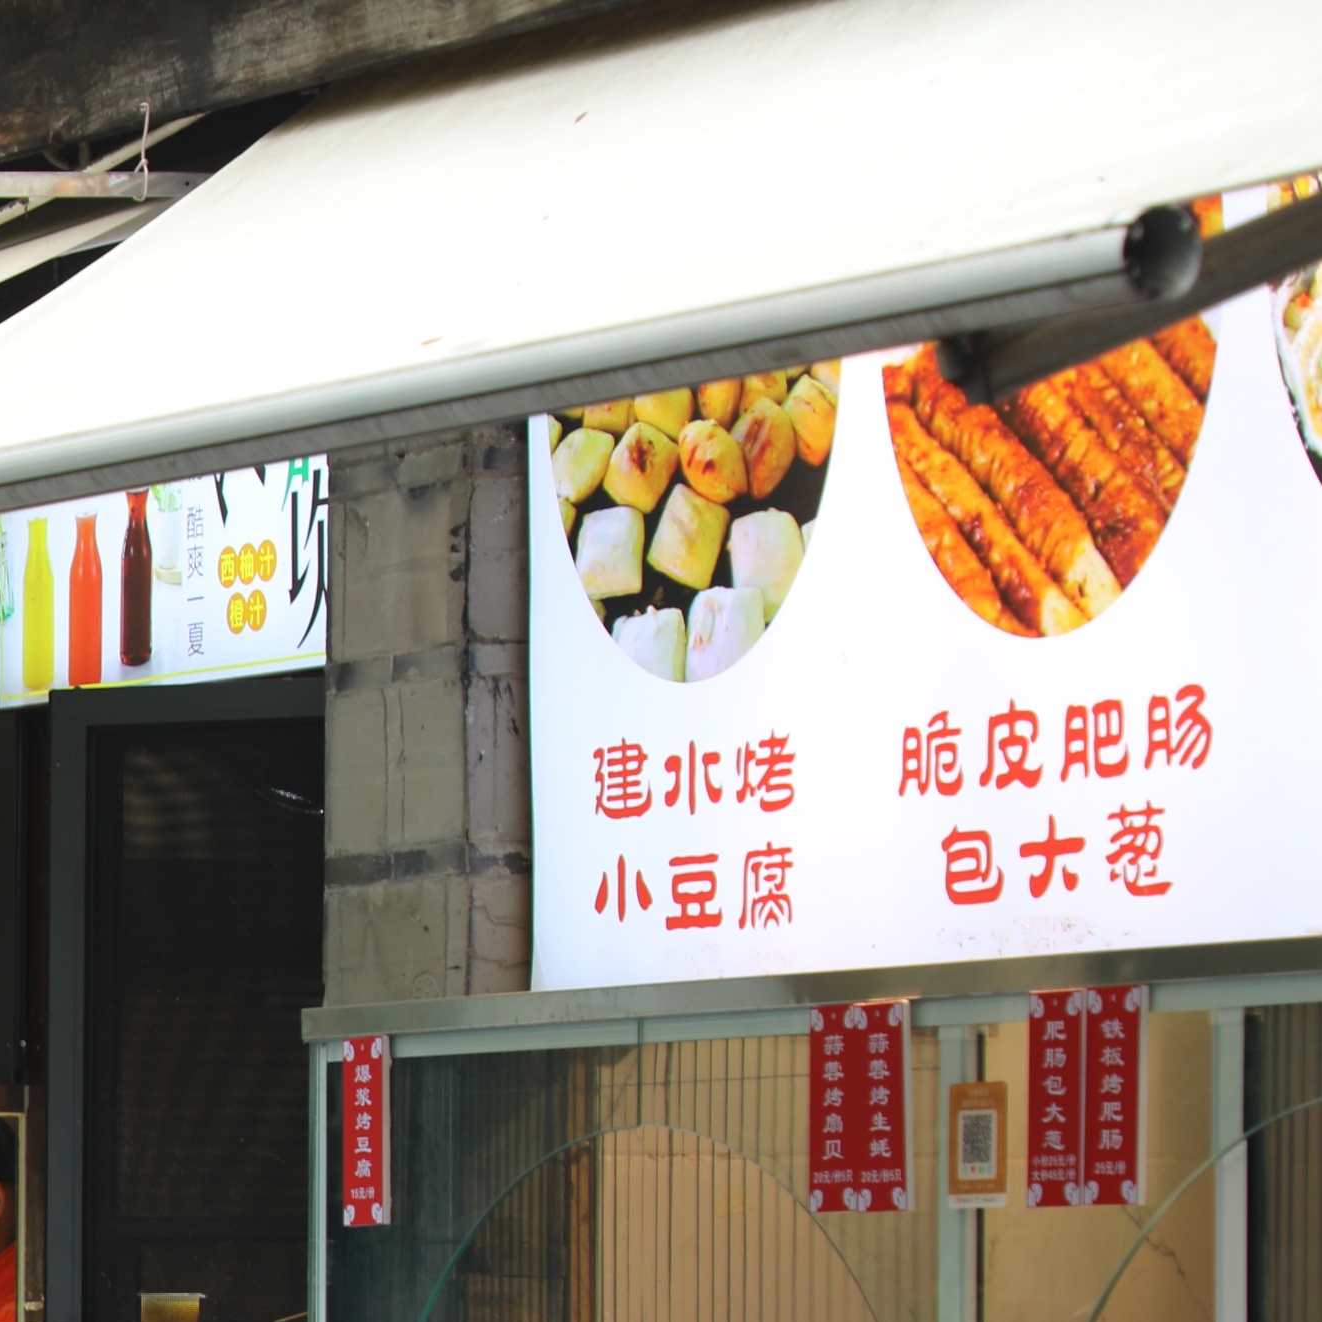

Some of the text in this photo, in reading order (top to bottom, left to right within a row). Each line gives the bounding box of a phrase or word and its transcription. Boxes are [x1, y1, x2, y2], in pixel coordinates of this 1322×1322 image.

[220, 545, 275, 583] 西柚汁
[229, 595, 264, 630] 橙汁
[592, 729, 797, 819] 建水烤
[898, 684, 1214, 797] 脆皮肥肠
[594, 841, 795, 931] 小豆腐
[941, 800, 1173, 905] 包大葱
[354, 1064, 373, 1178] 爆浆烤豆腐
[822, 1034, 844, 1161] 蒜蓉烤扇贝
[867, 1032, 892, 1159] 蒜蓉烤生蚝
[1042, 1021, 1068, 1151] 肥肠包大葱
[1099, 1019, 1125, 1151] 铁板烤肥肠
